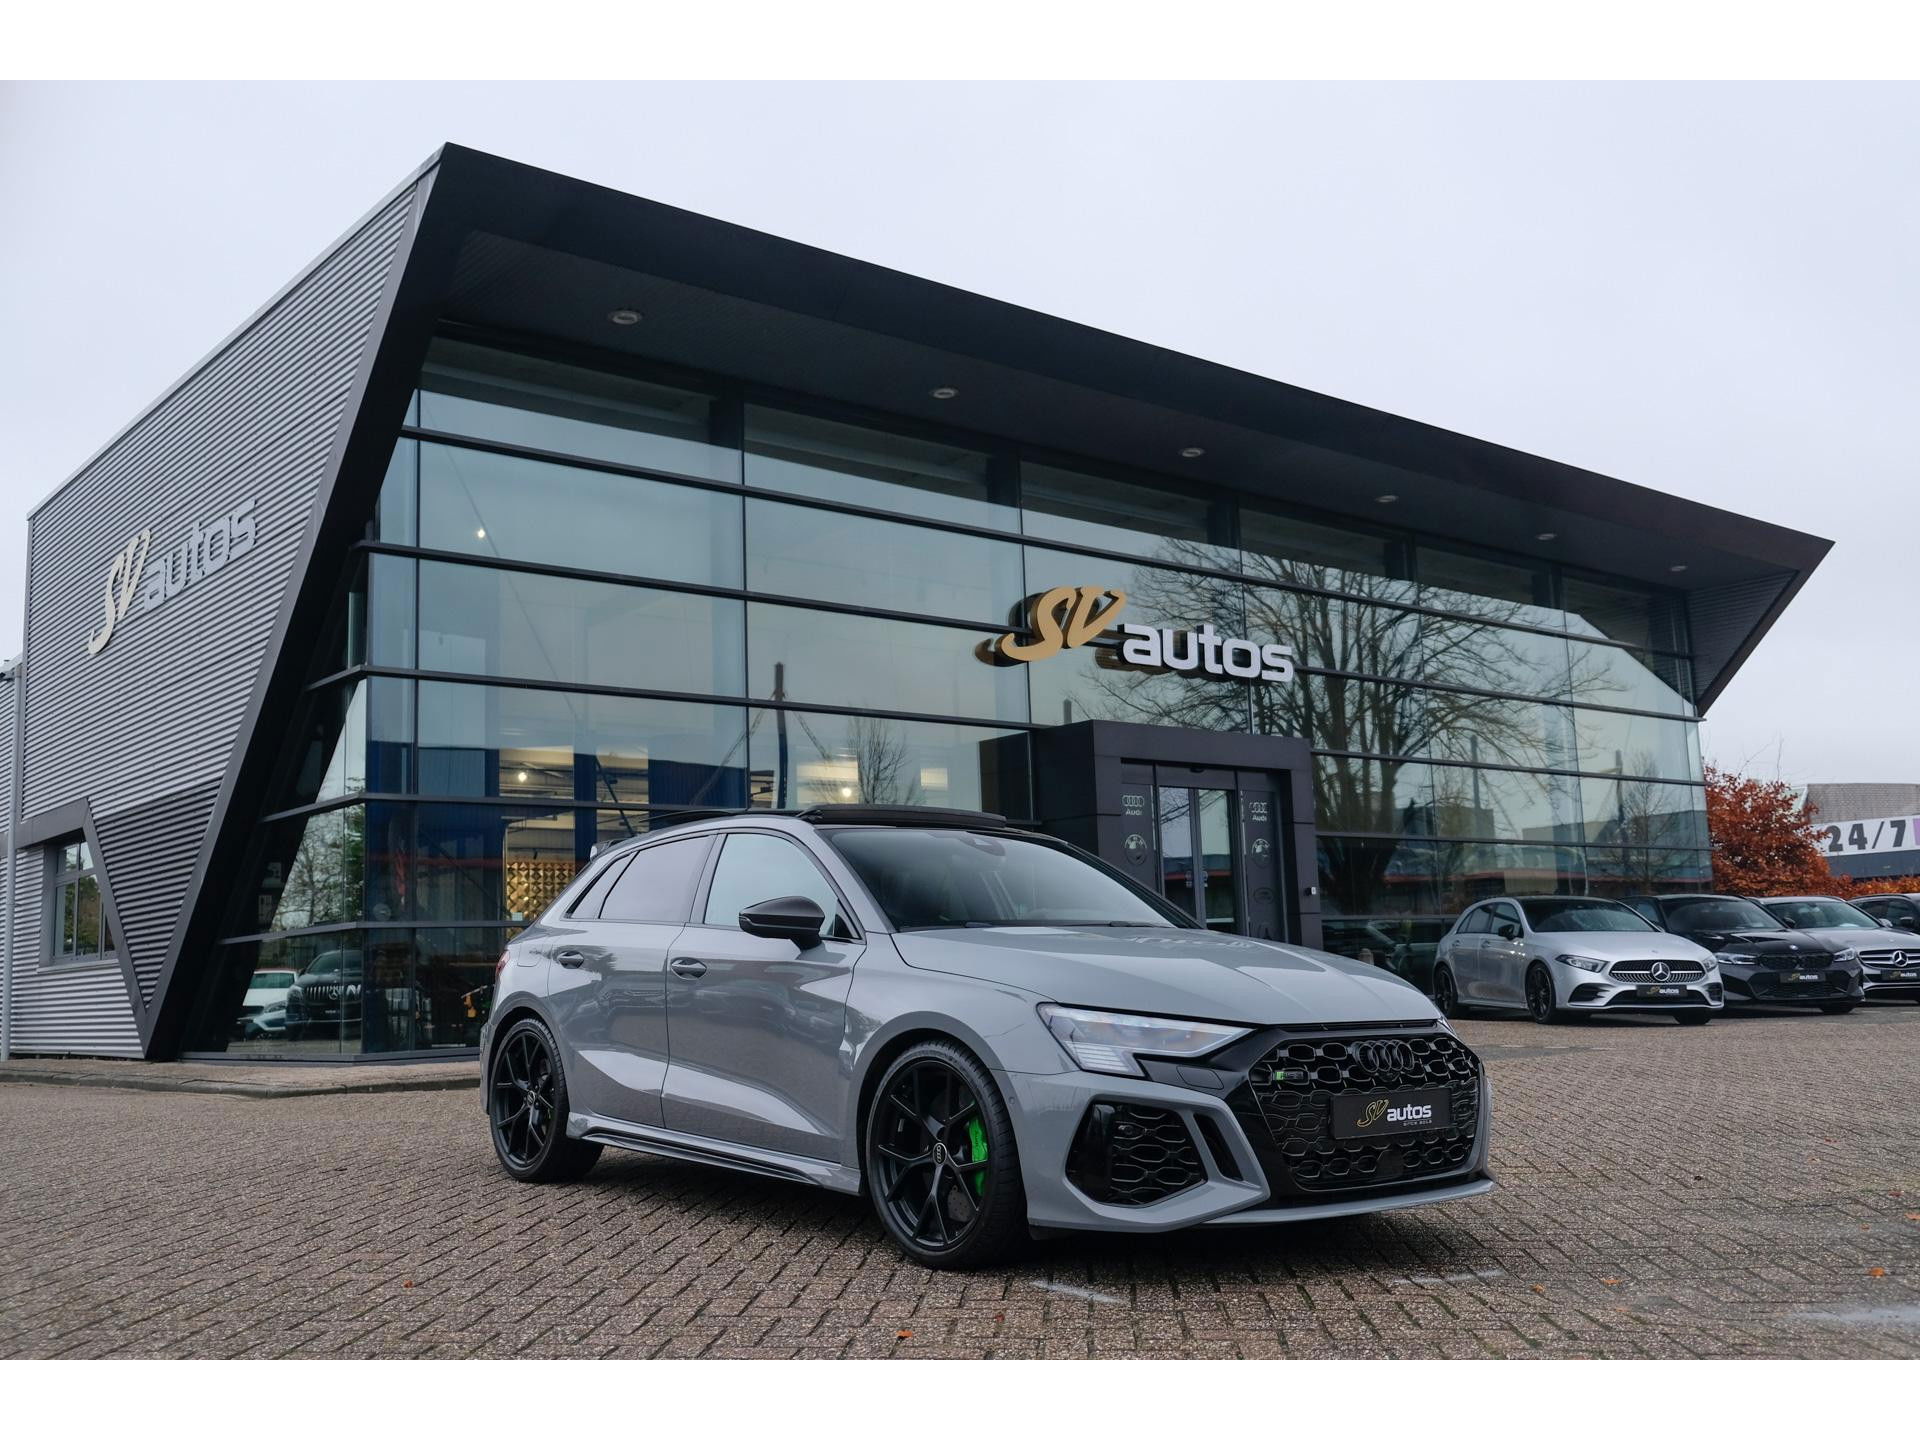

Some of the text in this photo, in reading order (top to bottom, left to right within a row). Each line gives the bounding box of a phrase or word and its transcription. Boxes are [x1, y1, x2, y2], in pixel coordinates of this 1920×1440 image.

[144, 499, 256, 610] autos
[1001, 586, 1294, 683] SV autos
[1825, 819, 1906, 852] 24/7
[1386, 1104, 1432, 1121] autos
